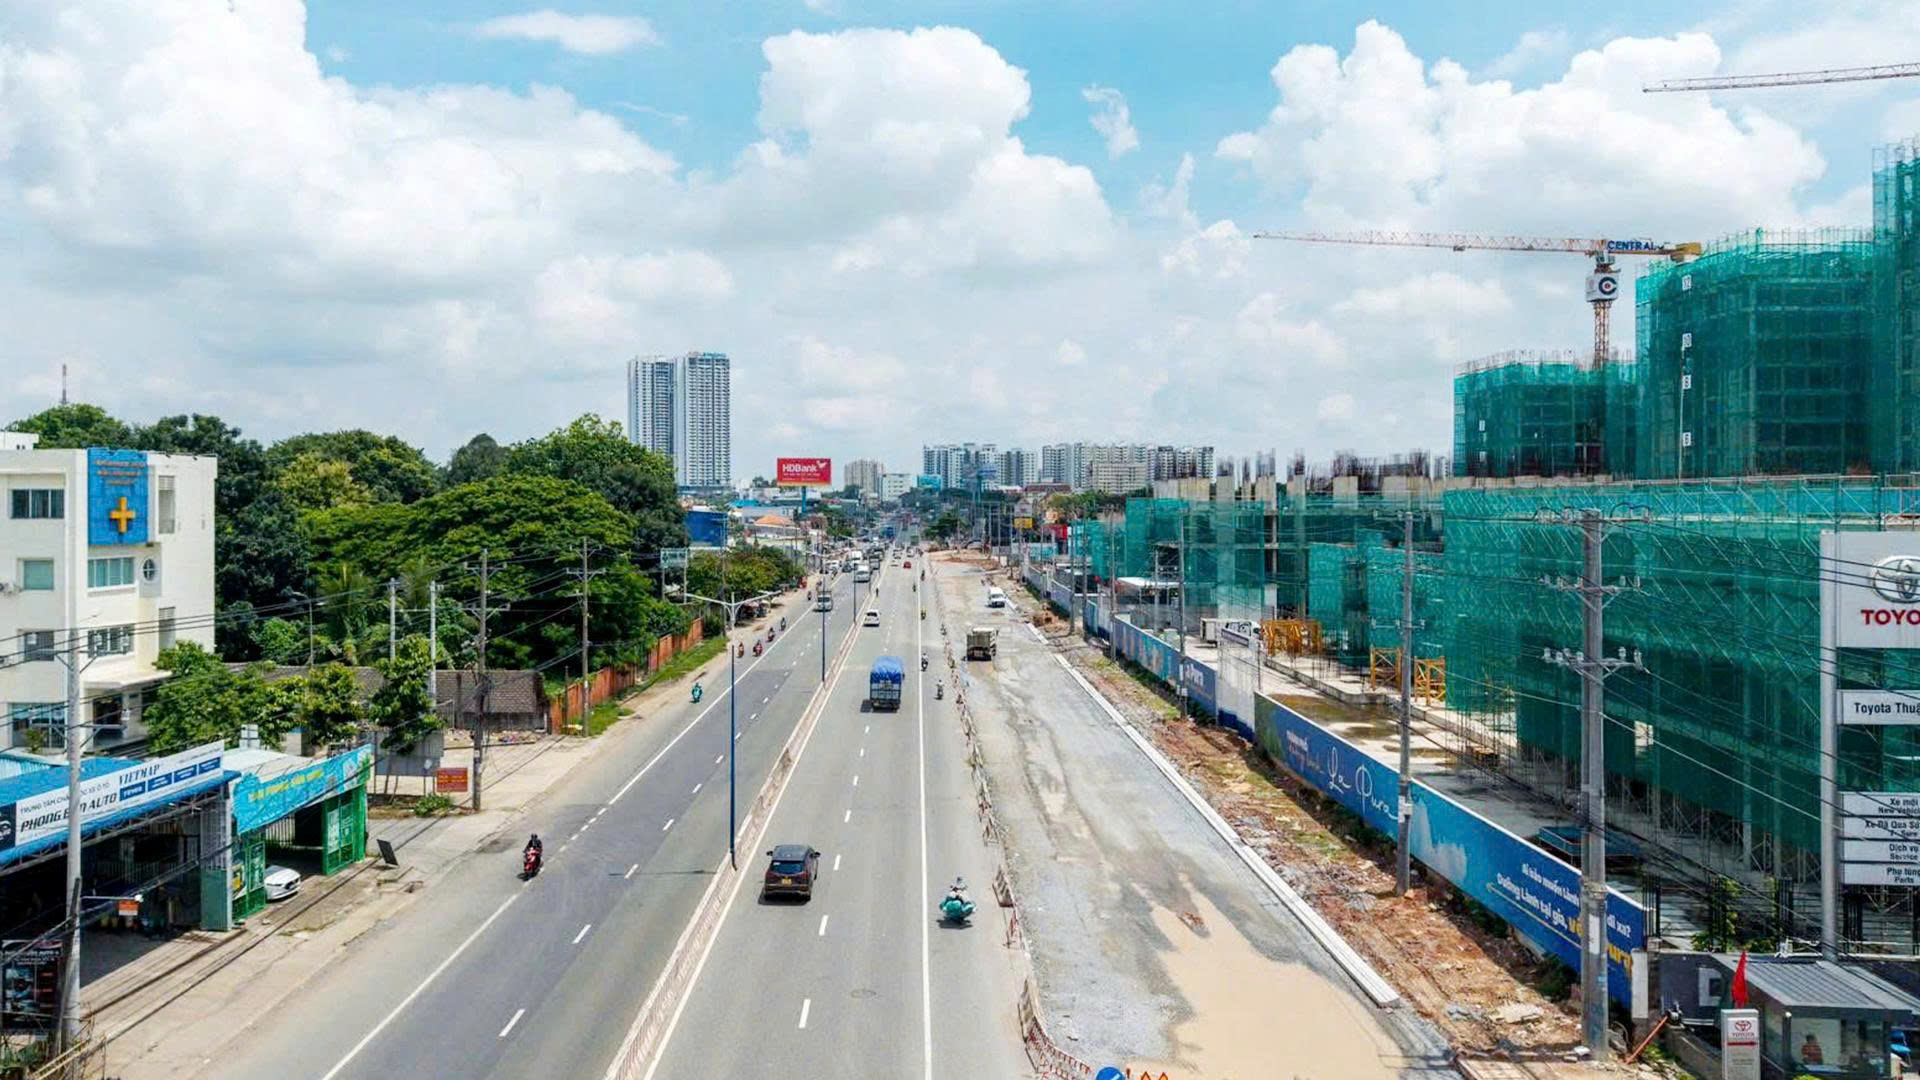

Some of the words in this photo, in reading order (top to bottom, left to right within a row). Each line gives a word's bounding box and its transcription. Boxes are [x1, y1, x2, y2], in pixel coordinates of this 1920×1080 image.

[1608, 240, 1656, 250] CENTRAL
[783, 463, 817, 473] HDBank
[1854, 702, 1891, 715] Toyota
[89, 792, 117, 809] AUTO
